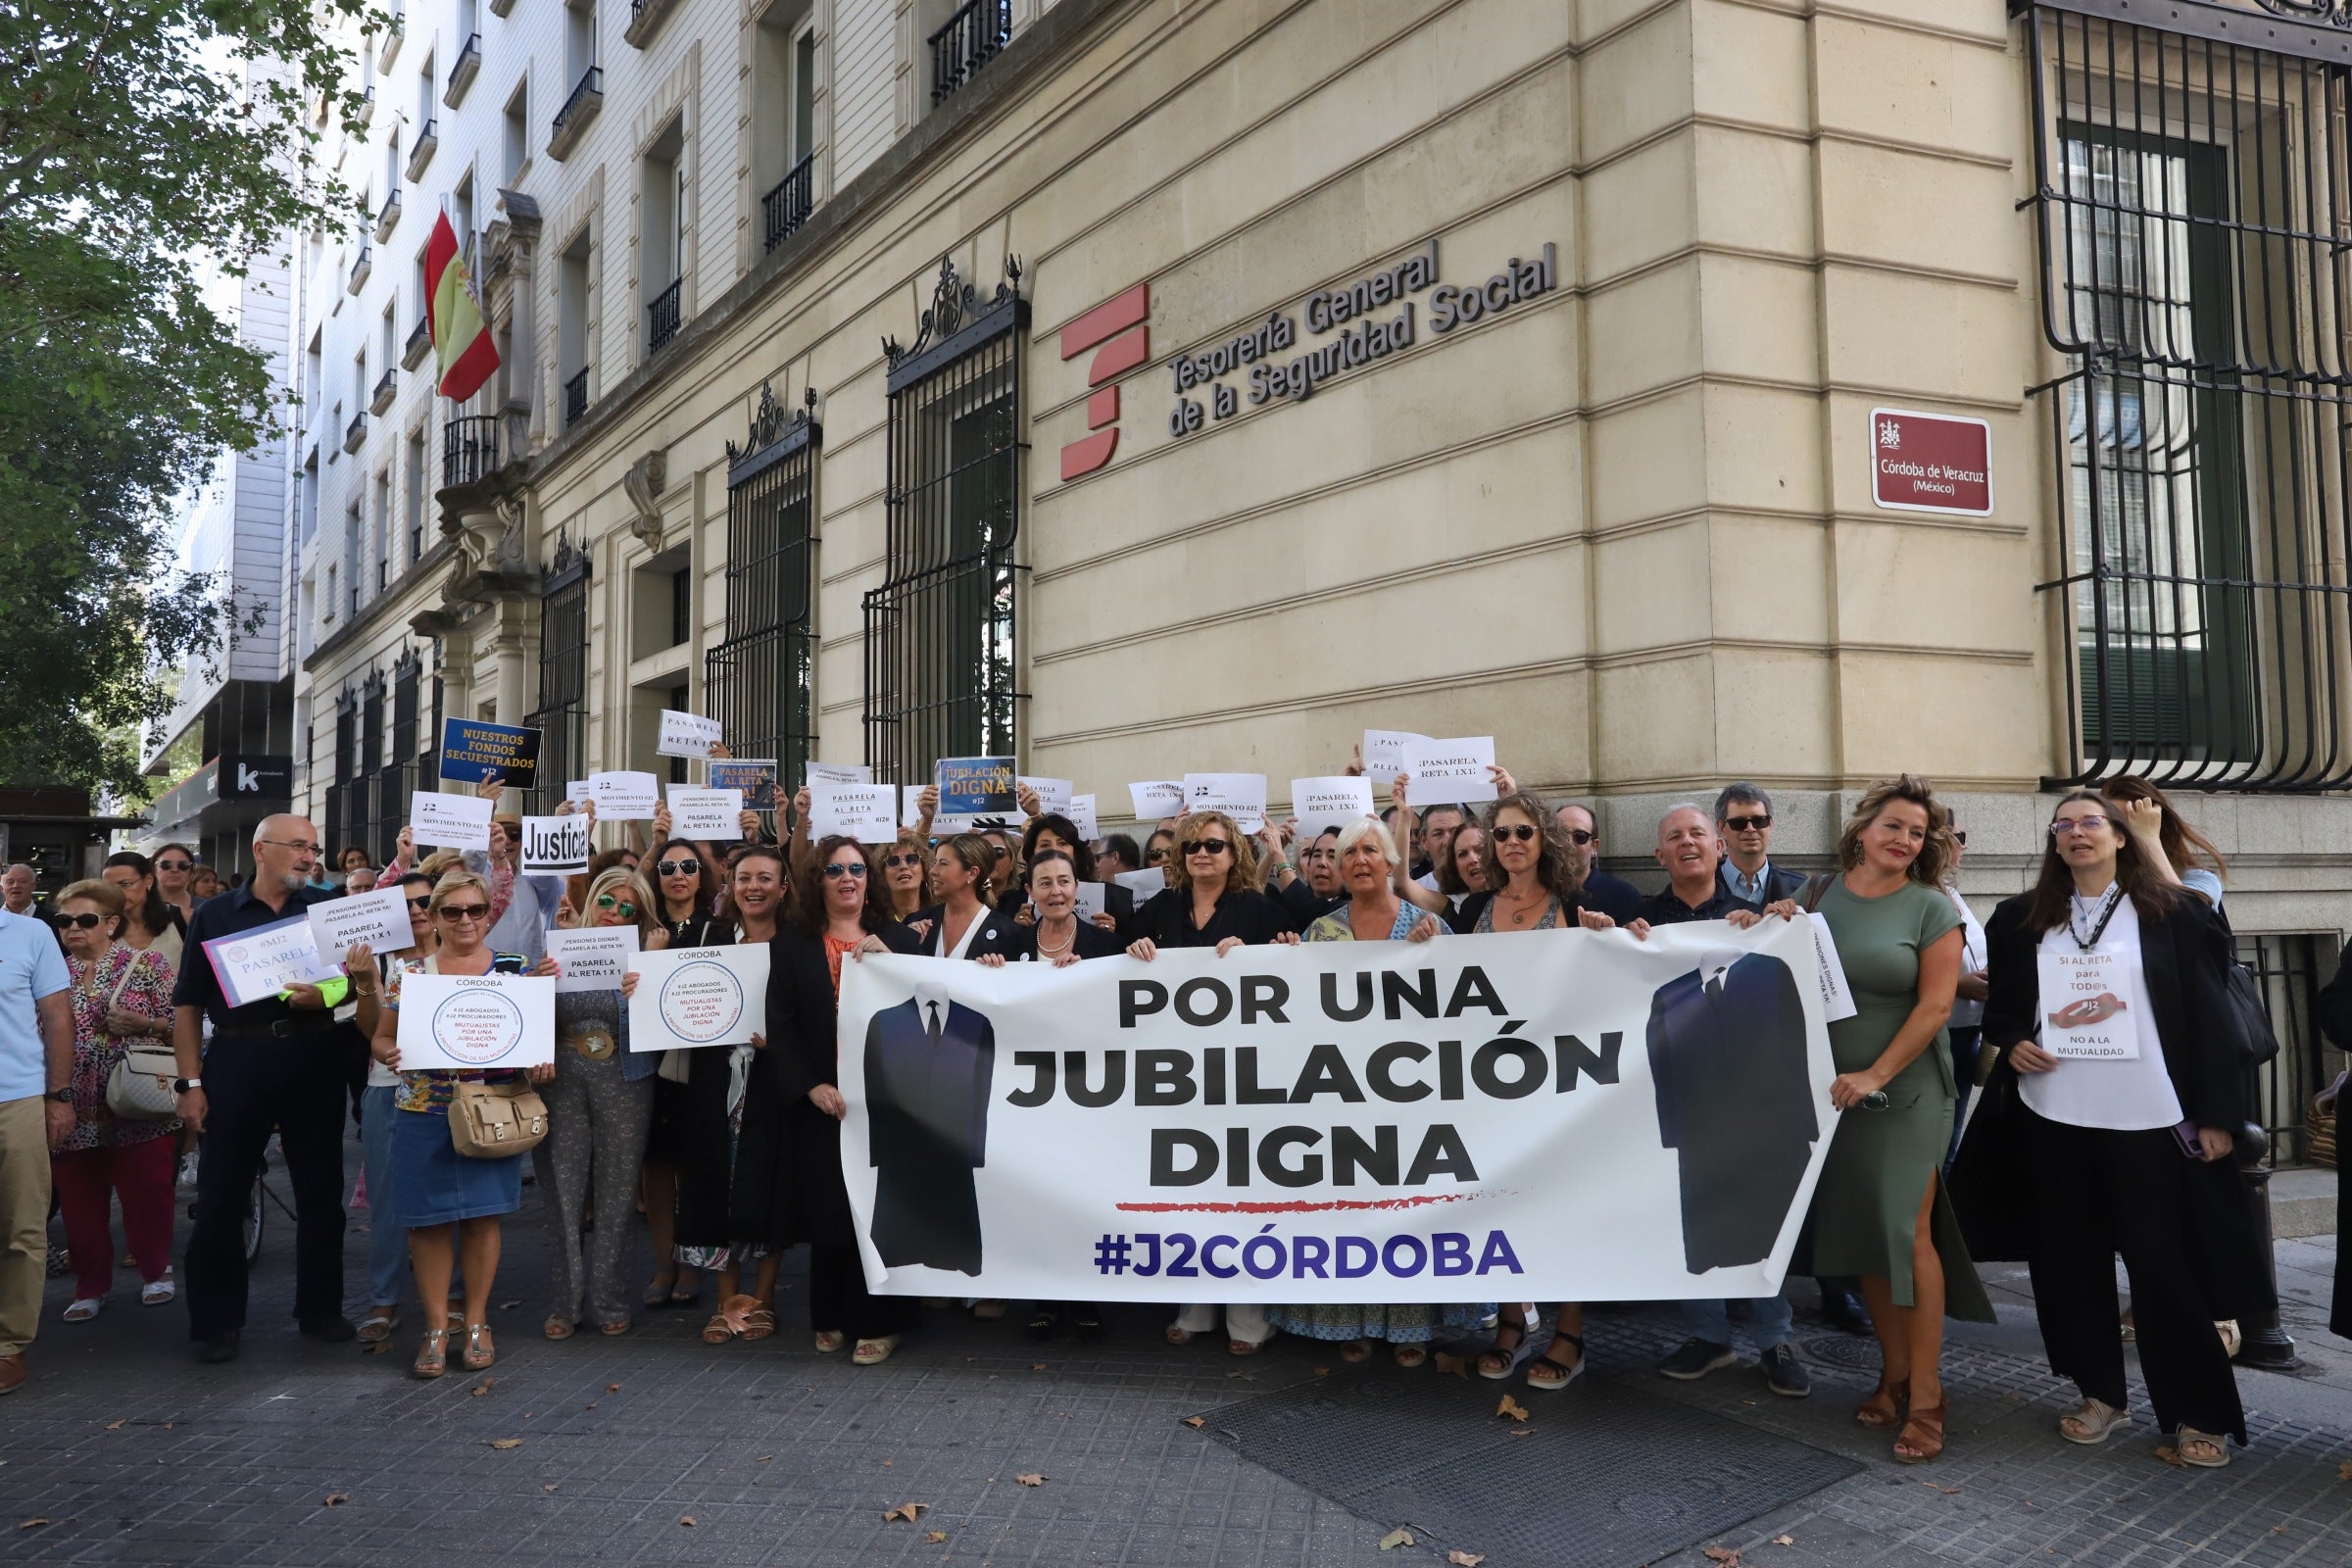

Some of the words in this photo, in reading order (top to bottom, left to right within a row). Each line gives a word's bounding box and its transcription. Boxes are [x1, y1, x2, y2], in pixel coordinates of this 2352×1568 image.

[1167, 312, 1295, 394] Tesorería
[1304, 238, 1440, 334] General
[1168, 397, 1203, 437] de
[1212, 382, 1238, 419] la
[1248, 302, 1414, 405] Seguridad
[1430, 241, 1556, 332] Social
[1881, 459, 1925, 476] Córdoba
[1927, 464, 1940, 478] de
[1942, 465, 1984, 483] Veracruz
[1913, 479, 1955, 496] (México)
[667, 717, 721, 735] PASARELA
[463, 728, 524, 745] NUESTROS
[667, 736, 698, 746] RETA
[468, 741, 515, 756] FONDOS
[446, 749, 535, 768] SECUESTRADOS
[238, 762, 259, 791] k
[719, 767, 767, 777] PASARELA
[946, 764, 1011, 780] JUBILACIÓN
[1421, 769, 1449, 778] RETA
[739, 776, 762, 785] RETA
[950, 778, 1008, 796] DIGNA
[832, 793, 876, 802] PASARELA
[422, 818, 471, 828] MOVIMIENTO
[337, 921, 384, 937] PASARELA
[259, 935, 288, 949] #MJ2
[347, 935, 369, 946] RETA
[241, 945, 318, 974] PASARELA
[571, 958, 615, 967] PASARELA
[2059, 956, 2069, 965] SI
[2088, 956, 2113, 964] RETA
[264, 966, 315, 988] RETA
[2076, 970, 2100, 979] para
[1118, 974, 1291, 1029] POR
[1319, 965, 1508, 1022] UNA
[2082, 1001, 2099, 1010] #J2
[2057, 1047, 2125, 1055] MUTUALIDAD
[1005, 1019, 1623, 1108] JUBILACIÓN
[1149, 1123, 1480, 1189] DIGNA
[1094, 1223, 1525, 1280] #J2CÓRDOBA
